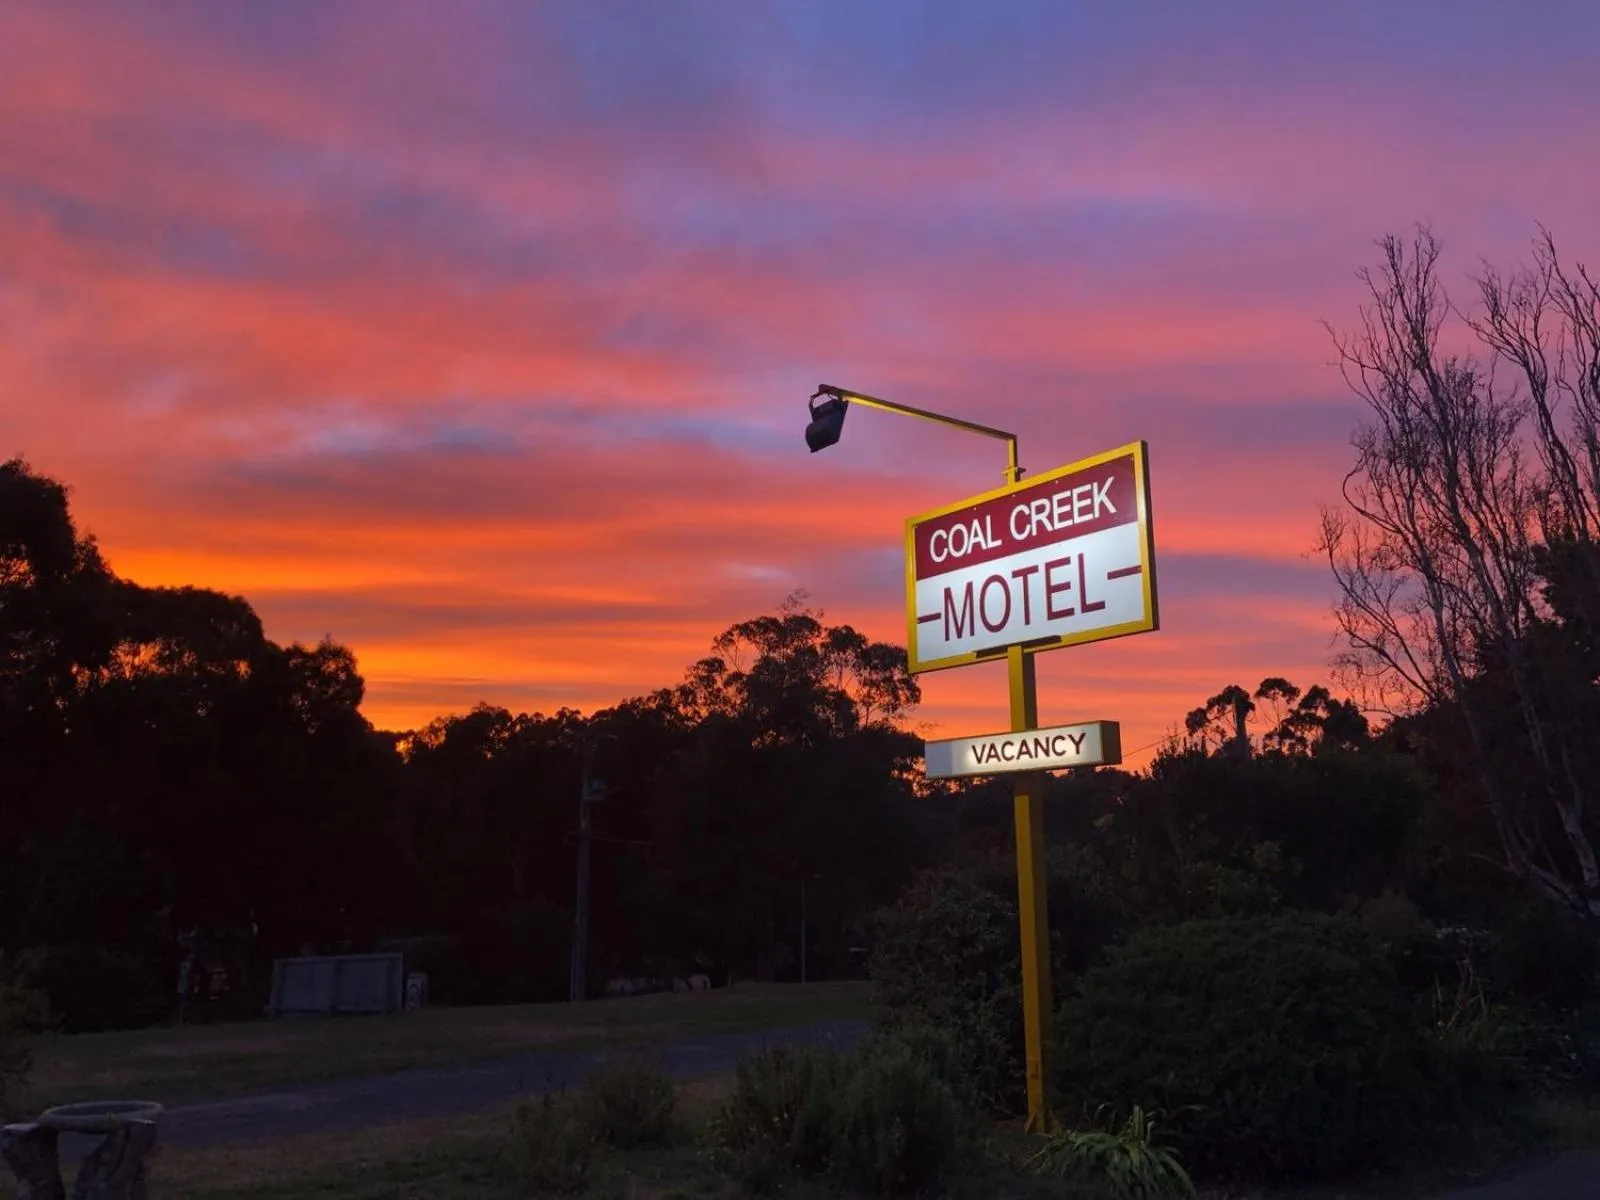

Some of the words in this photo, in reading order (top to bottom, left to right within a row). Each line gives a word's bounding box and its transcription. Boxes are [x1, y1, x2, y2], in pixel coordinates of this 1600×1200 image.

[929, 514, 1002, 563] COAL
[1009, 476, 1117, 541] CREEK
[943, 552, 1106, 642] MOTEL
[971, 731, 1087, 765] VACANCY
